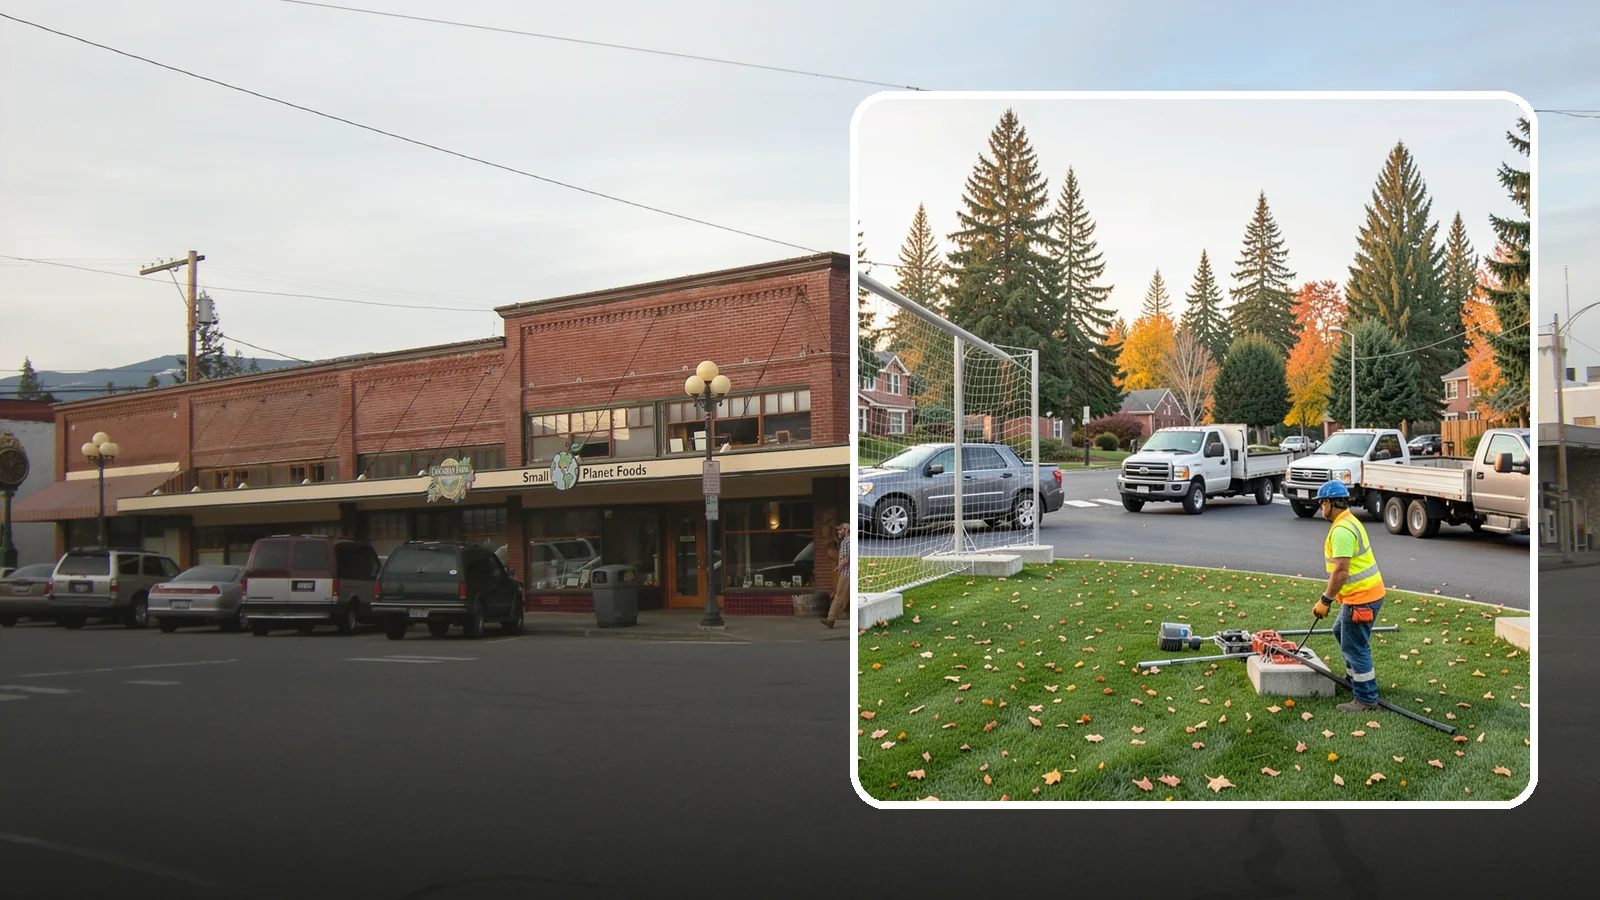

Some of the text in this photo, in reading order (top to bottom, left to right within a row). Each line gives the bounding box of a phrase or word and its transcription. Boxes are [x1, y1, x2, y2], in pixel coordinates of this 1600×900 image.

[523, 464, 647, 483] Small Planet Foods
